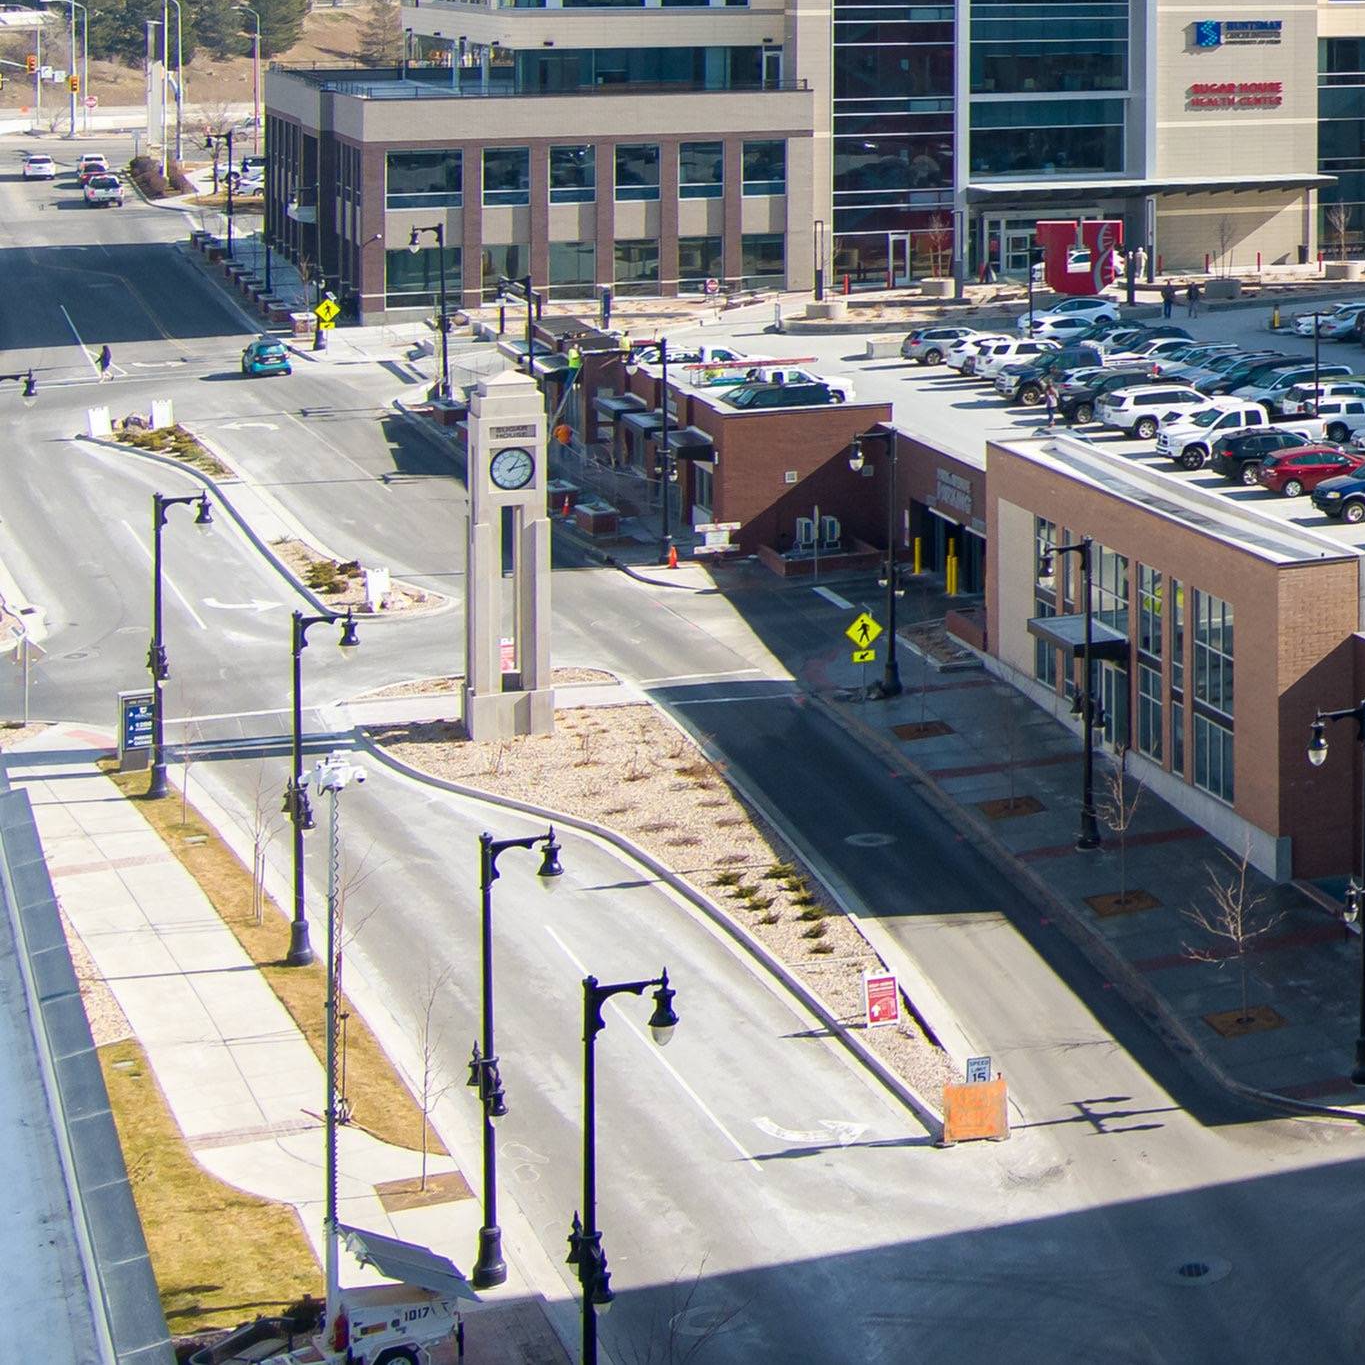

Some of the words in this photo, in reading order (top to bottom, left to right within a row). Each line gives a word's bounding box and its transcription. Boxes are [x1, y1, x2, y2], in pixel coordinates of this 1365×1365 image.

[1192, 84, 1236, 94] SUGAR
[1240, 82, 1282, 93] HOUSE
[1191, 97, 1235, 107] HEALTH
[972, 1072, 987, 1082] 15
